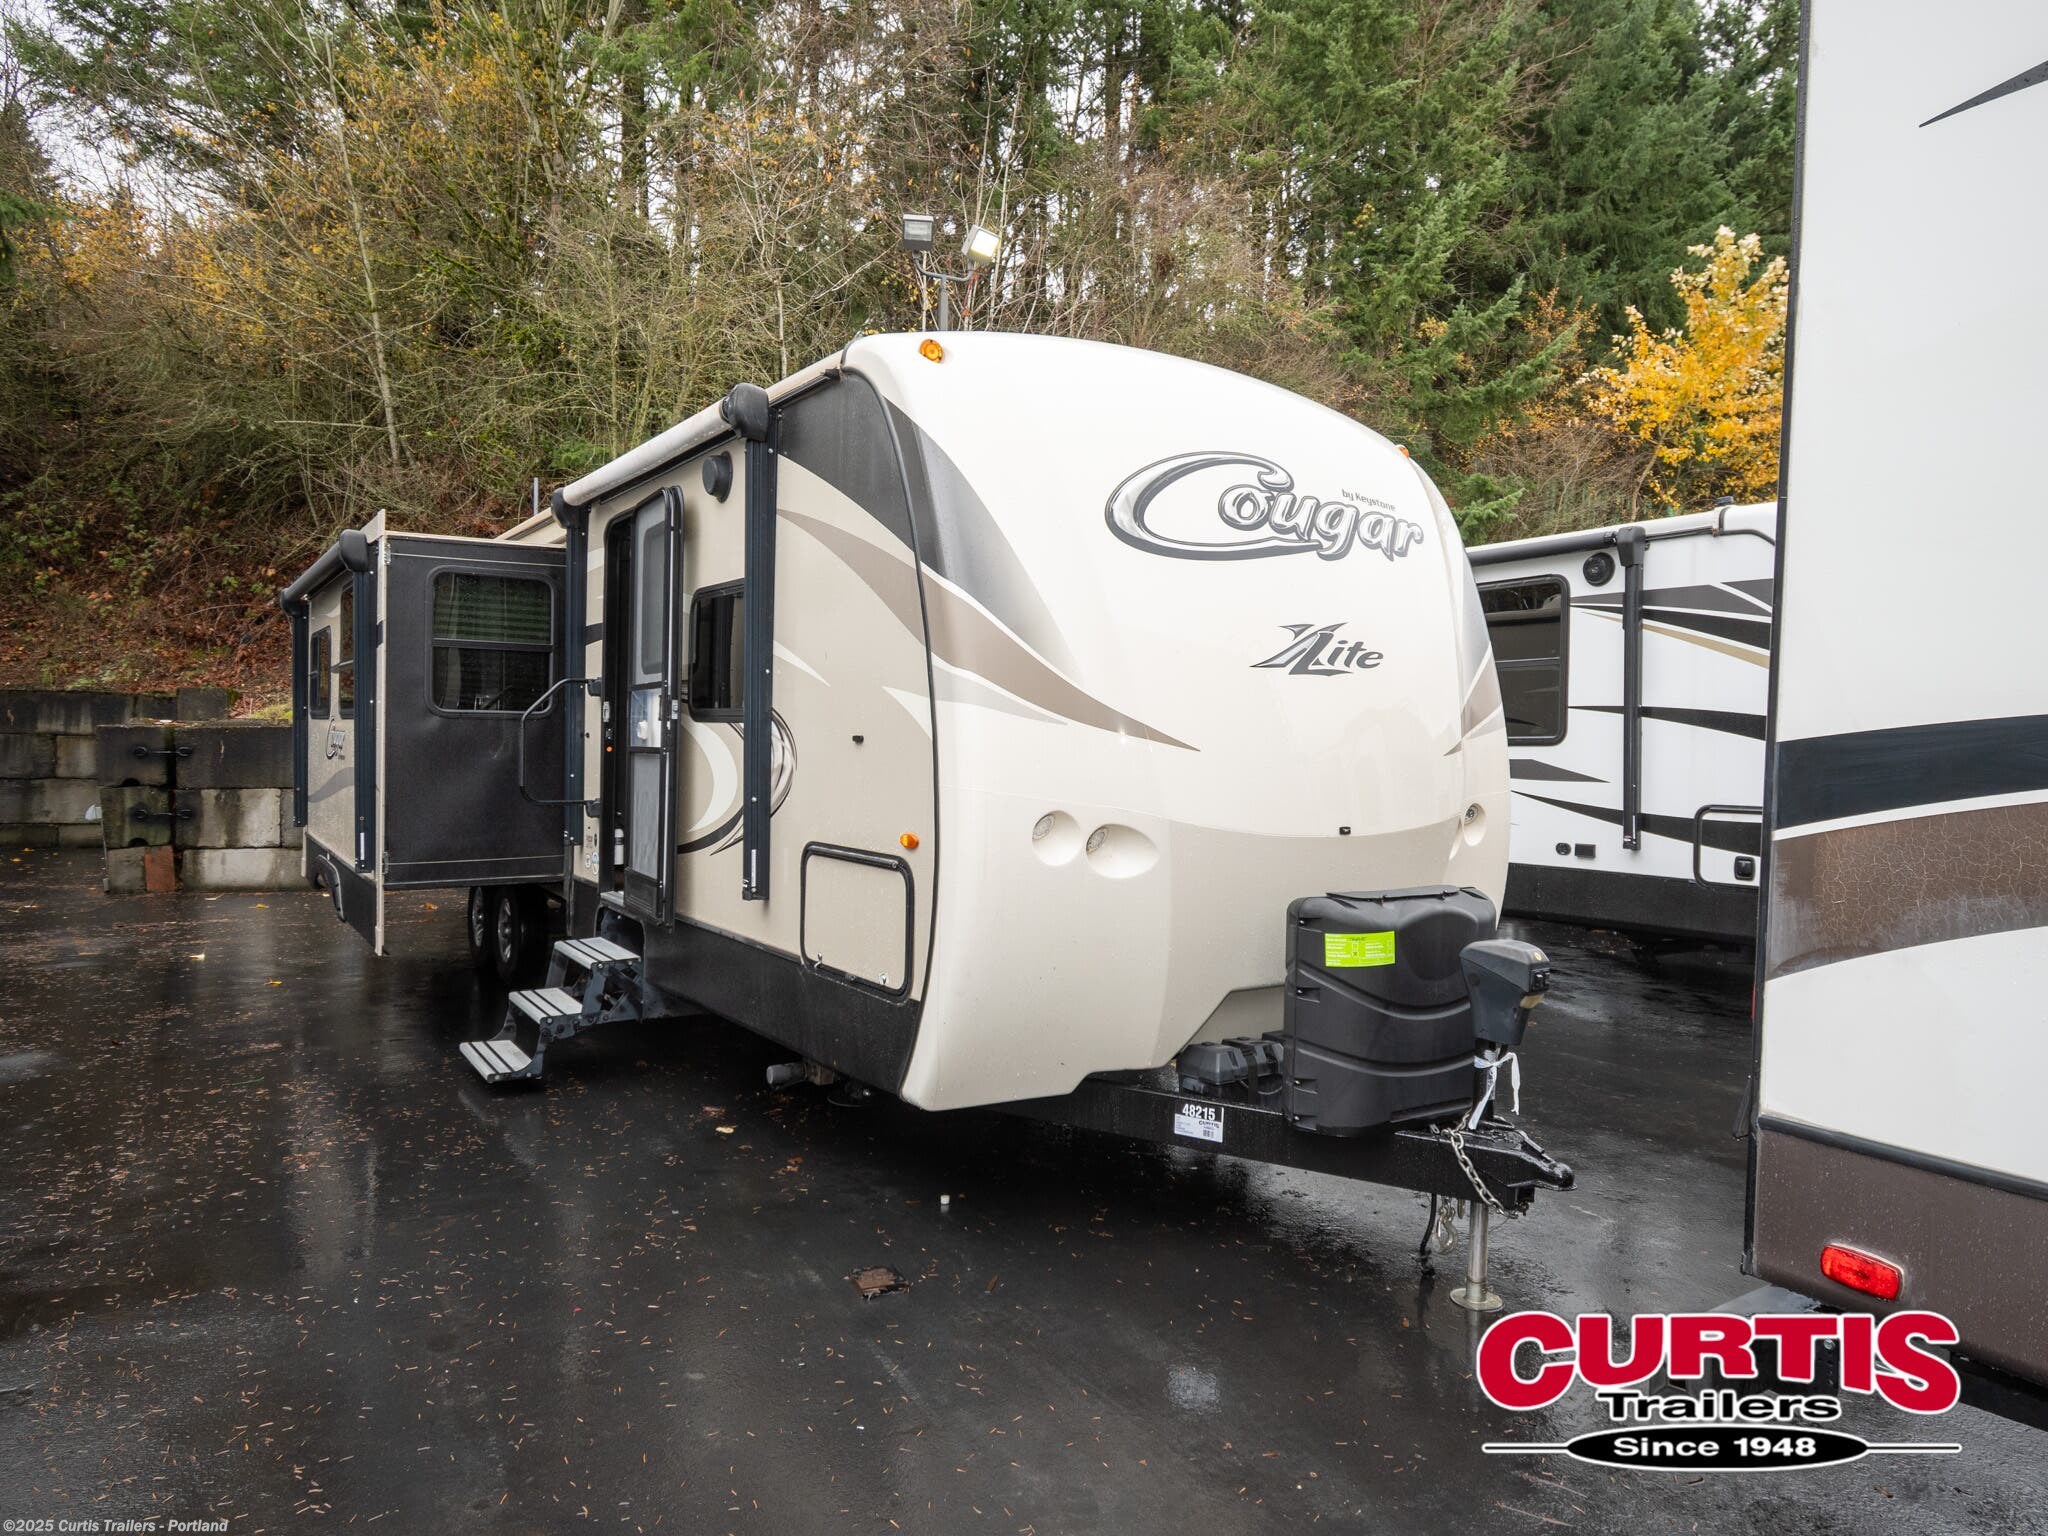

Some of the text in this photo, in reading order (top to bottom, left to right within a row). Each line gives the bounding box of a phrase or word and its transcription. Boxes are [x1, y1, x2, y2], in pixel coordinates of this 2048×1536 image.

[1105, 451, 1424, 561] Cougar
[1341, 488, 1396, 511] by Keystone
[1182, 1103, 1216, 1121] 48215
